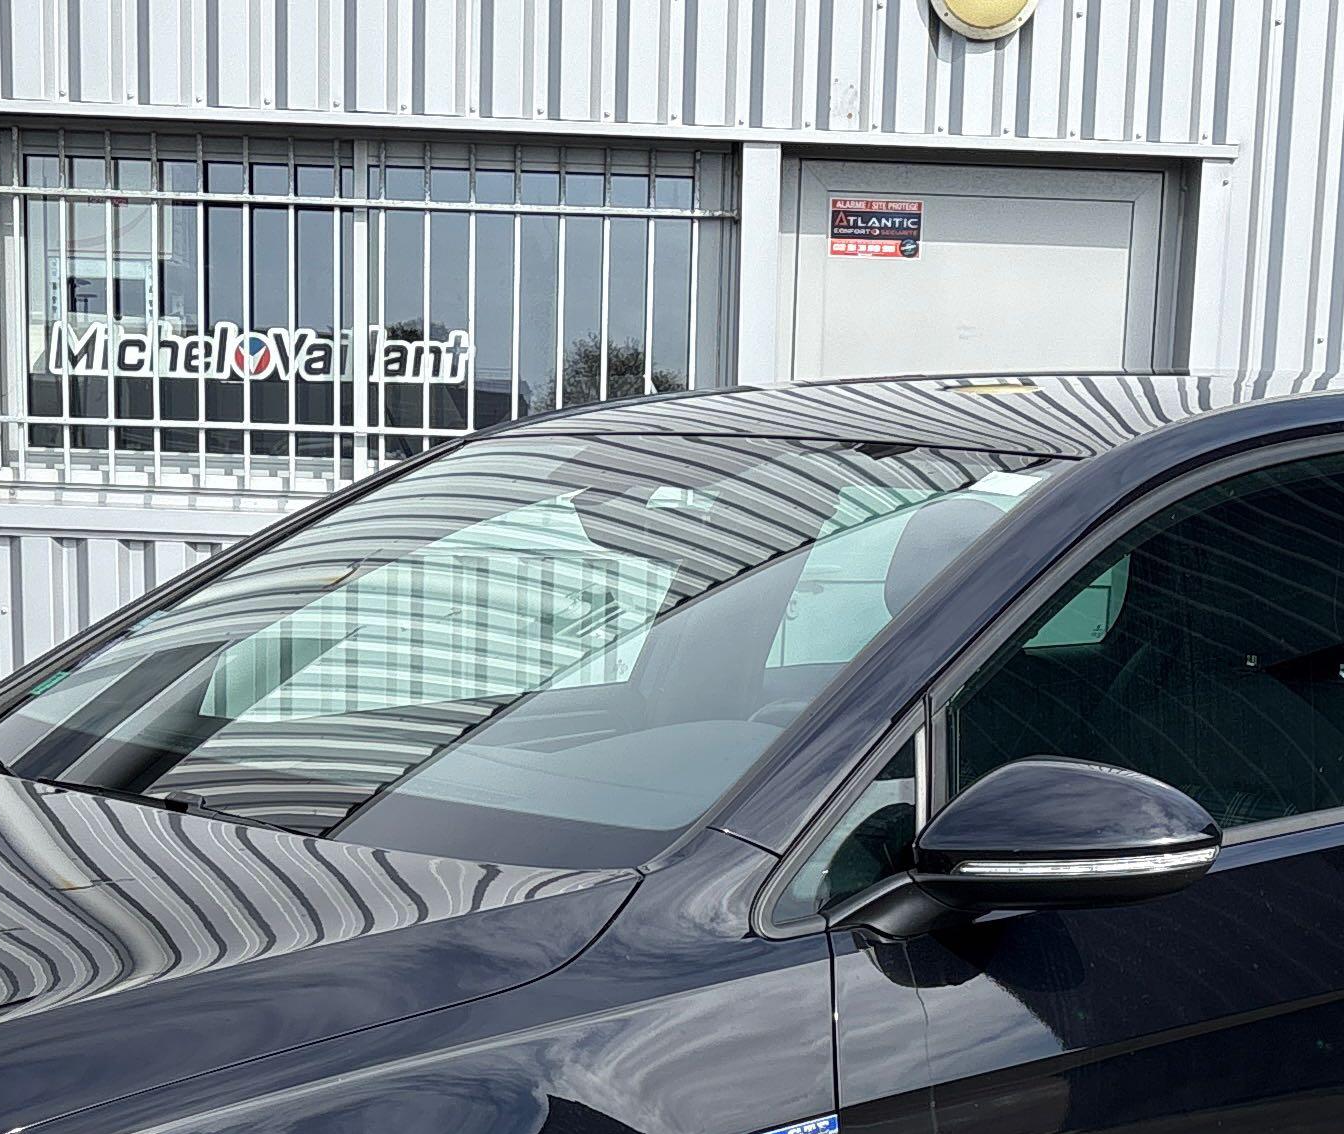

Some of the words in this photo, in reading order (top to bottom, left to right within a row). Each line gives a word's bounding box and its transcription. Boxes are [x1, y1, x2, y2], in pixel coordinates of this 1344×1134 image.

[836, 200, 866, 209] ALARME
[871, 201, 887, 210] SITE
[835, 211, 918, 229] ATLANTIC
[50, 321, 230, 375] Michel
[270, 328, 470, 380] Vailant
